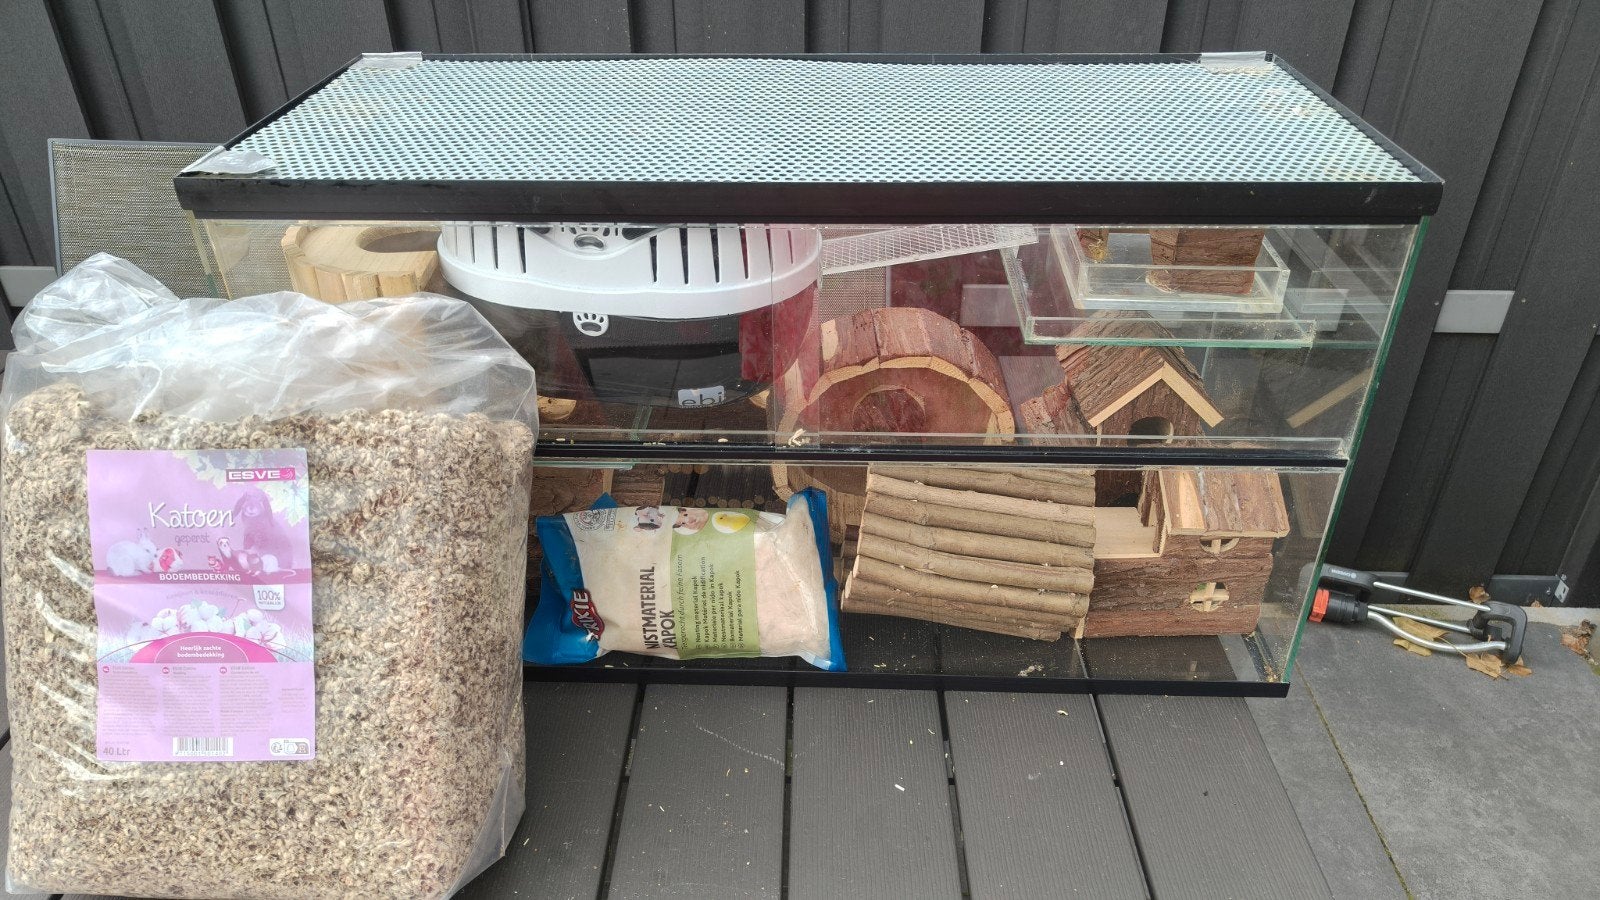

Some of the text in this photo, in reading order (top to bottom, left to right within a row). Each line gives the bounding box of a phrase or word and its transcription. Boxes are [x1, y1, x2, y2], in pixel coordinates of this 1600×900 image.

[682, 391, 722, 406] ebi
[229, 471, 281, 480] ESVE
[148, 501, 235, 528] Katoen
[175, 533, 210, 545] geperst
[159, 573, 241, 582] BODEMBEDEKKING
[257, 590, 281, 601] 100%
[640, 565, 659, 649] NISTMATERIAL
[660, 610, 678, 649] KAPOK
[102, 747, 131, 756] 40 Ltr
